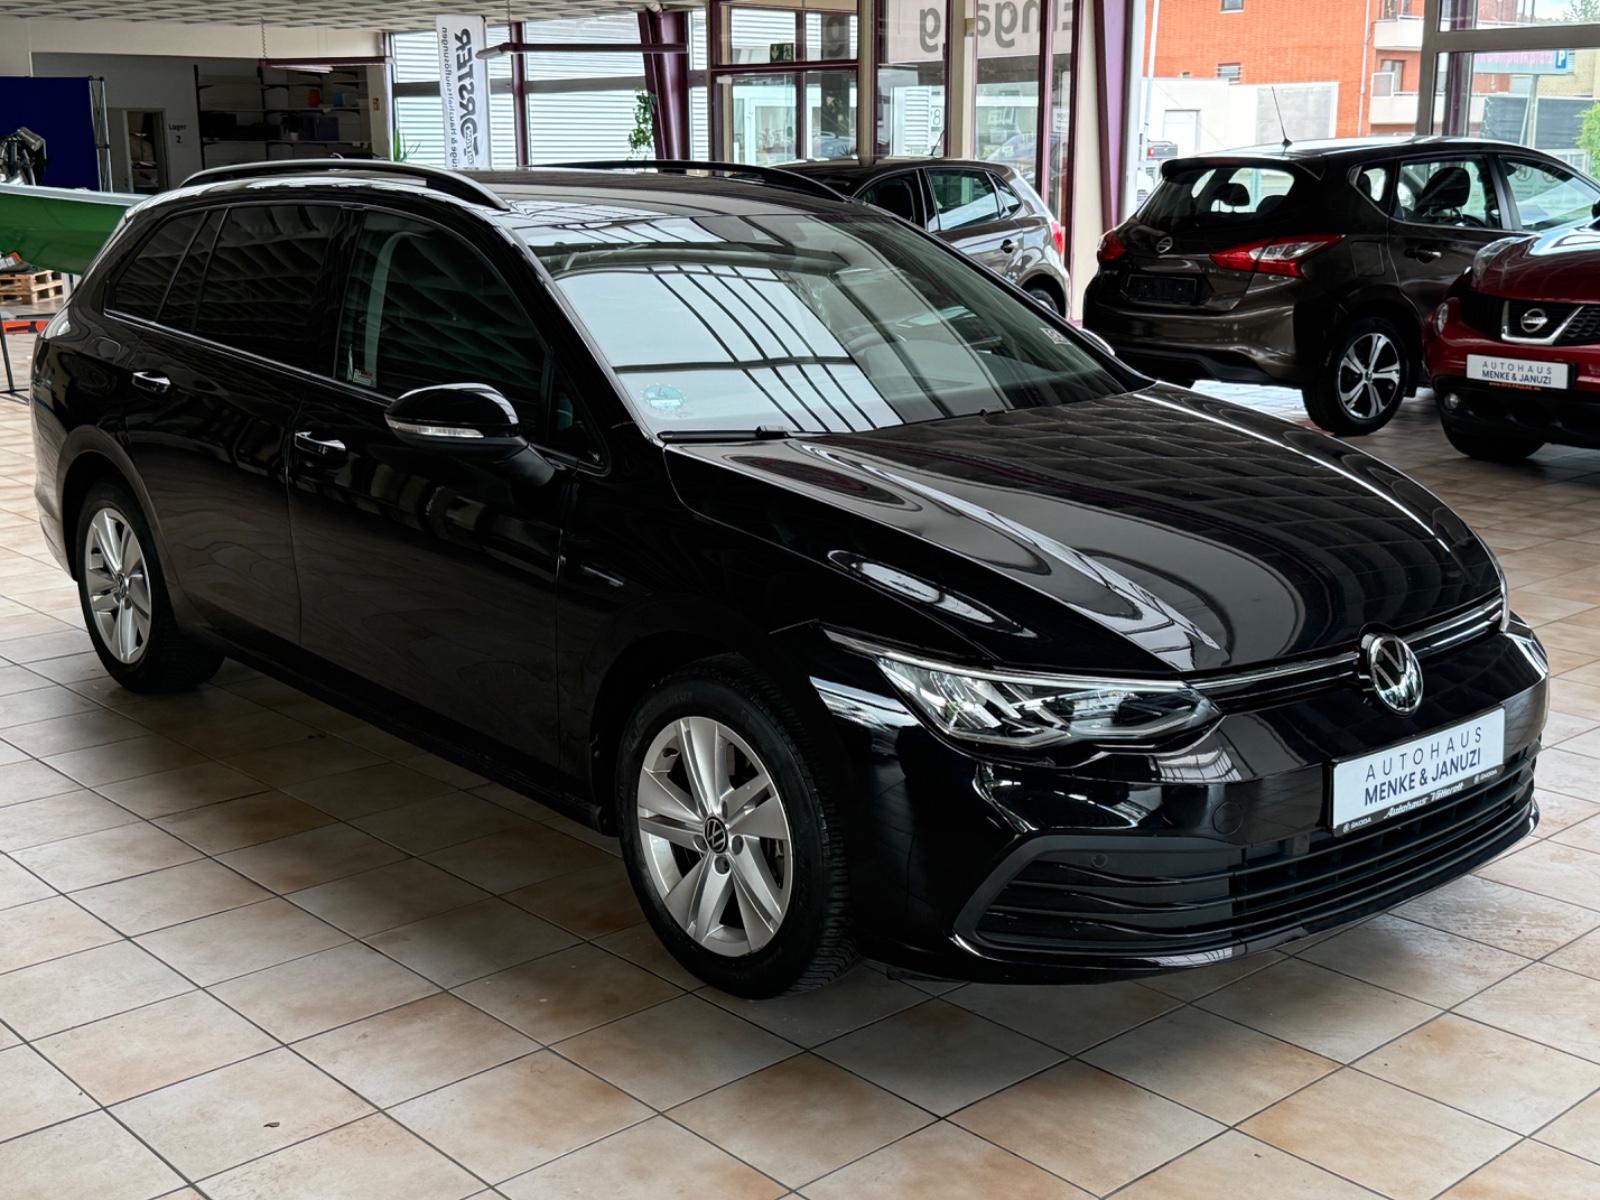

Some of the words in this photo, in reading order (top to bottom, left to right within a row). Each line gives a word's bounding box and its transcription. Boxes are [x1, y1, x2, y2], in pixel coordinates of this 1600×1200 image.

[1482, 361, 1552, 375] AUTOHAUS
[1482, 370, 1510, 381] MENKE
[1511, 373, 1517, 382] &
[1519, 373, 1551, 385] JANUZI
[1365, 727, 1482, 782] AUTOHAUS
[1365, 771, 1415, 806] MENKE
[1419, 768, 1428, 787] &
[1431, 747, 1481, 782] JANUZI
